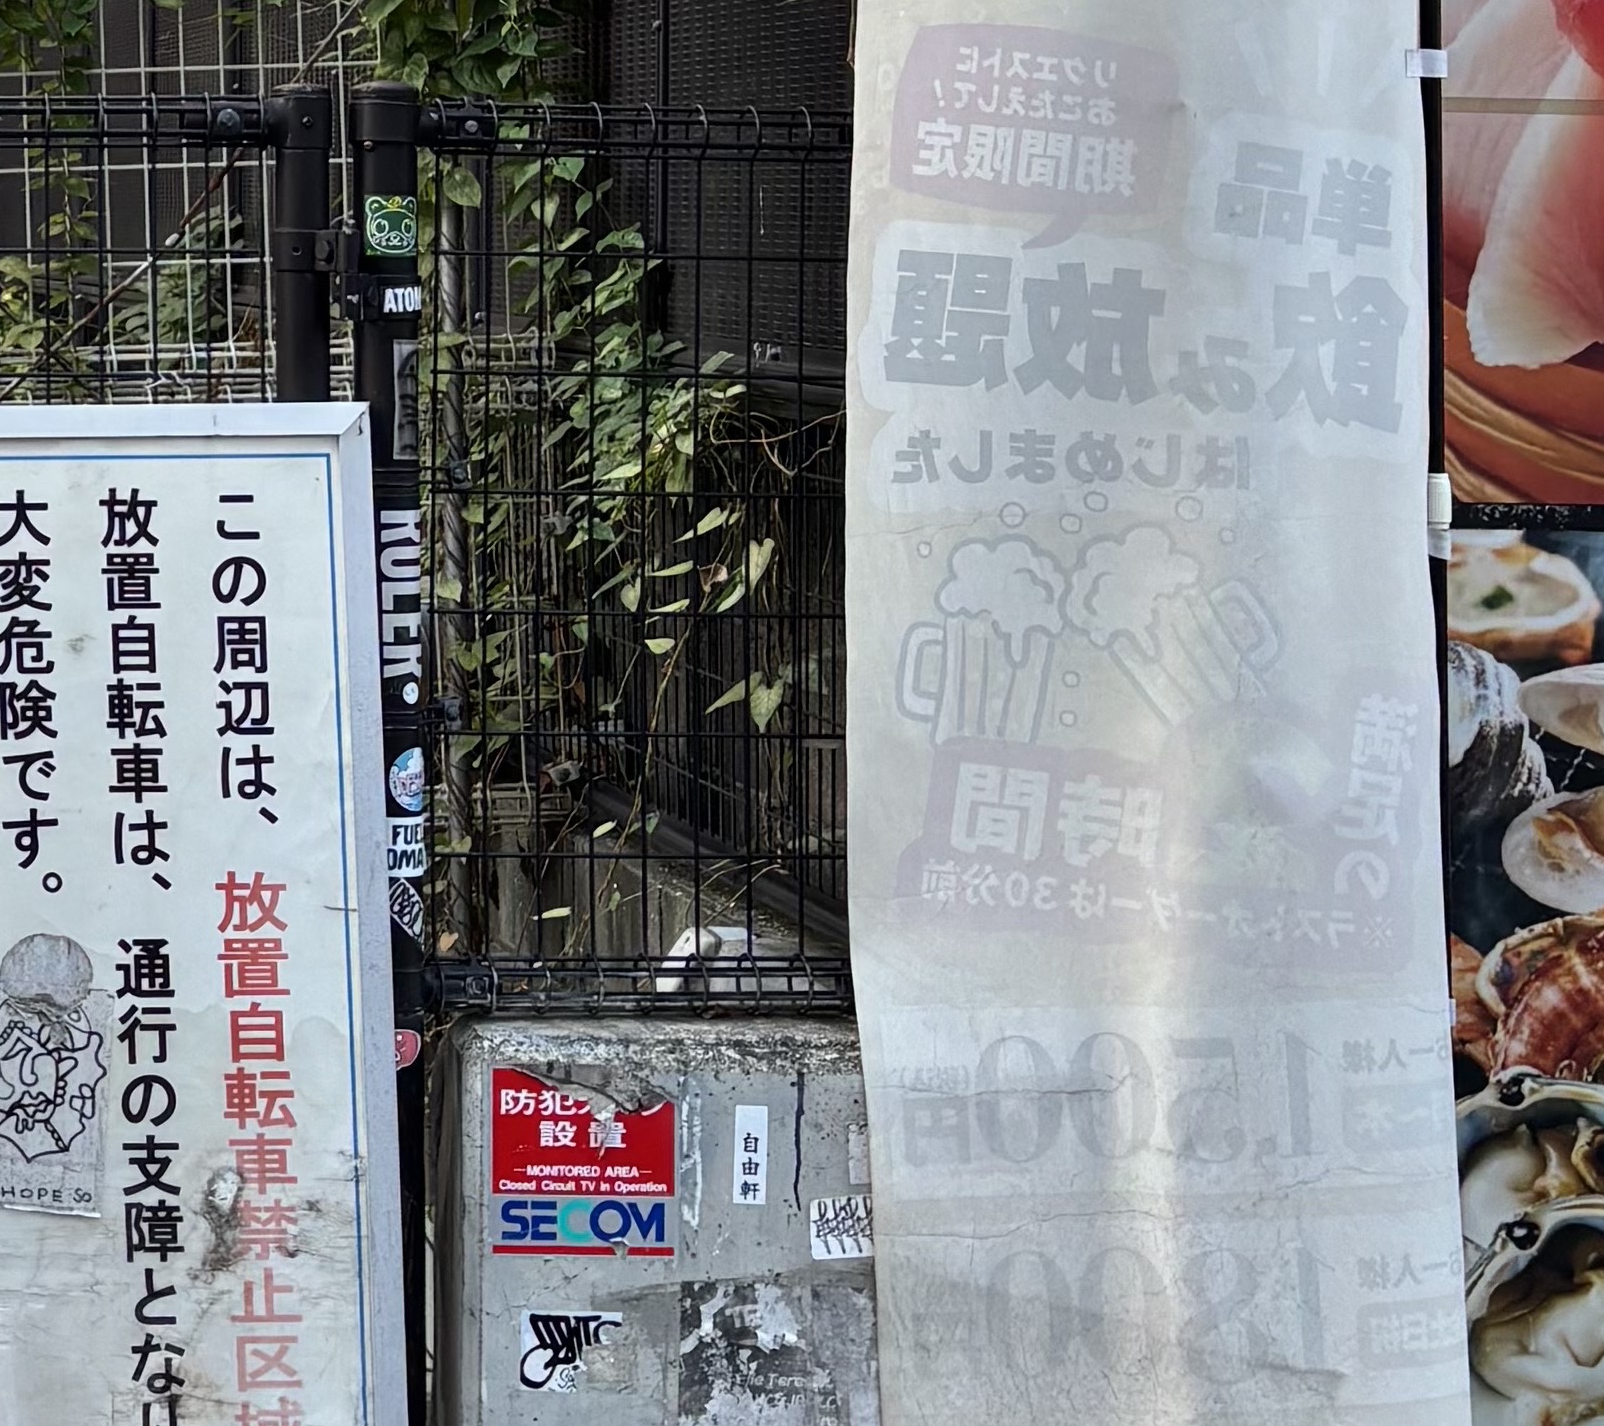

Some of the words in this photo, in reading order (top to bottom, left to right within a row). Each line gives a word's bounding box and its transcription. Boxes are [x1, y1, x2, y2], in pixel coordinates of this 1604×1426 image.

[539, 1120, 627, 1148] 設置
[526, 1164, 601, 1178] MONITORED
[604, 1165, 639, 1178] AREA
[739, 1131, 760, 1202] 自由軒
[1, 1185, 64, 1204] HOPE
[498, 1178, 536, 1191] Closed
[541, 1179, 576, 1192] Circuit
[580, 1180, 596, 1192] TV
[613, 1180, 667, 1194] Operation
[500, 1199, 666, 1244] SECOM
